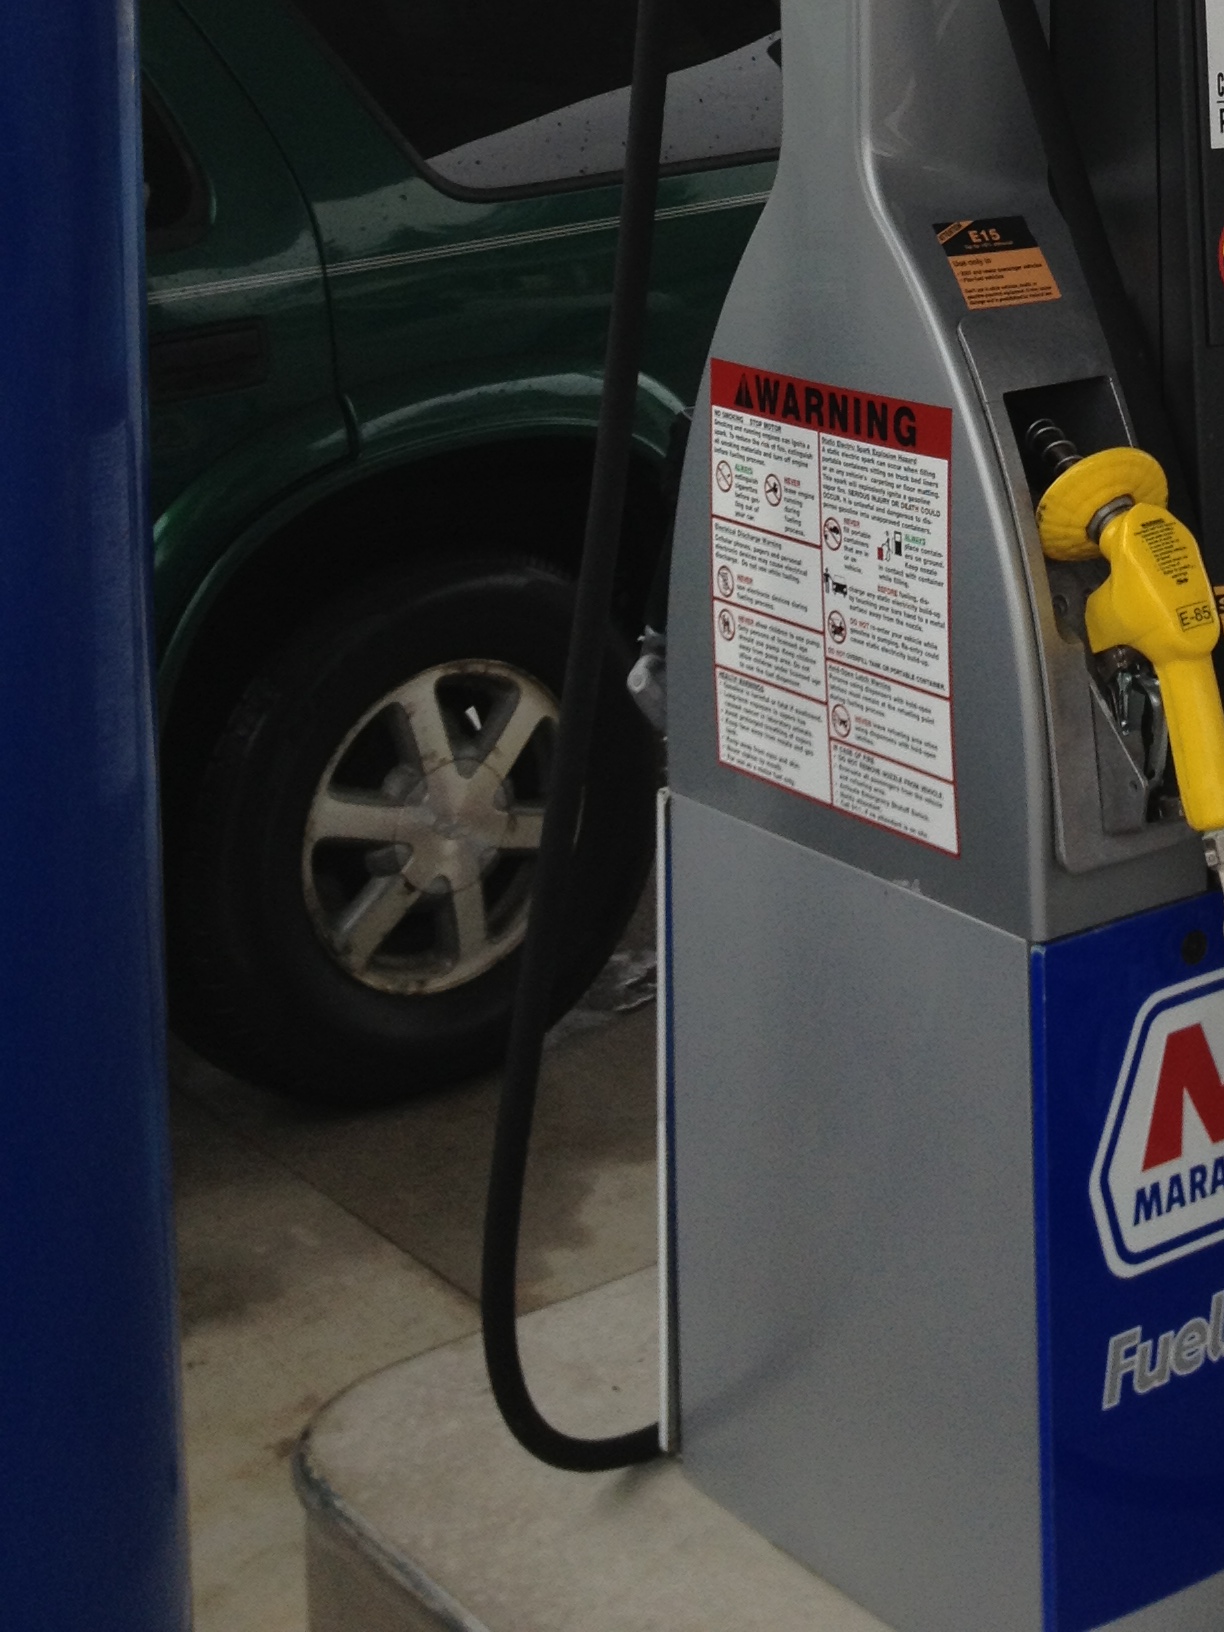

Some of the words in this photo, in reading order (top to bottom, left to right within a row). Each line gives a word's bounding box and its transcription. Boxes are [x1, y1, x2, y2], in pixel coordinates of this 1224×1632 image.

[968, 228, 1001, 244] E15
[755, 374, 917, 447] WARNING
[1180, 605, 1211, 626] E-85
